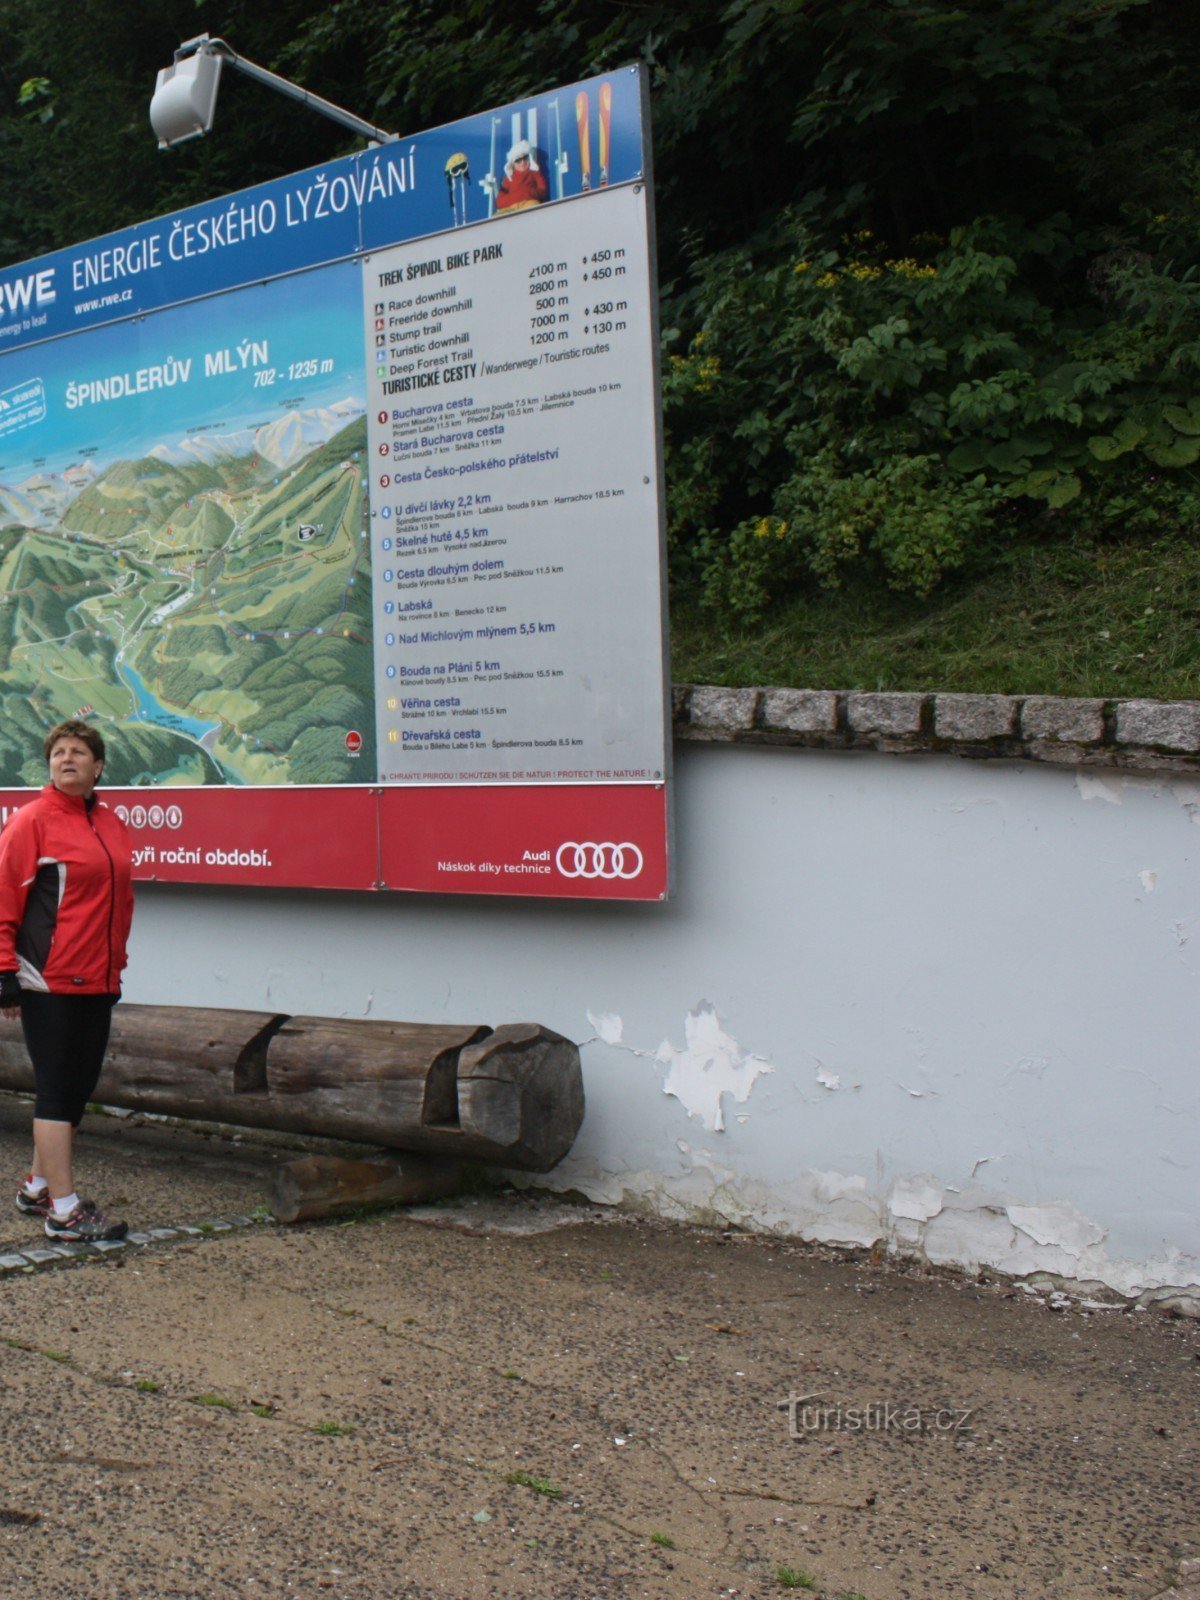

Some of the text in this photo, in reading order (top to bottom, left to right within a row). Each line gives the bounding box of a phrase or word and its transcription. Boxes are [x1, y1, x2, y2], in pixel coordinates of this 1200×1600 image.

[72, 235, 161, 291] ENERGIE
[168, 200, 276, 261] ČESKÉHO
[286, 145, 416, 227] LYŽOVÁNÍ
[378, 243, 503, 287] TREK ŠPINDL BIKE PARK
[528, 248, 626, 279] 2100 m 450 m
[529, 265, 626, 295] 2800 m 450 m
[74, 288, 133, 315] www.rwe.cz
[388, 286, 457, 312] Race downhill
[536, 296, 569, 310] 500 m
[389, 298, 473, 327] Freeride downhill
[530, 300, 628, 329] 7000 m 430 m
[0, 323, 22, 337] energy
[31, 312, 47, 327] lead
[389, 322, 442, 344] Stump trail
[530, 320, 627, 345] 1200 m 130 m
[390, 332, 470, 359] Turistic downhill
[382, 368, 440, 396] TURISTICKÉ
[443, 363, 477, 384] CESTY
[544, 348, 580, 363] Touristic
[582, 343, 610, 356] routes
[390, 348, 473, 375] Deep Forest Trail
[65, 338, 269, 409] ŠPINDLERŮV MLÝN
[253, 358, 334, 388] 702 1235 m
[491, 402, 514, 412] bouda
[527, 397, 539, 405] km
[544, 391, 571, 402] Labská
[573, 387, 597, 397] bouda
[609, 382, 621, 391] km
[392, 397, 474, 421] Bucharova cesta
[522, 406, 534, 415] km
[393, 424, 505, 453] Stará Bucharova cesta
[412, 448, 433, 458] bouda
[490, 438, 502, 446] km
[394, 447, 559, 485] Cesta Česko-polského přátelství
[395, 506, 402, 516] U
[457, 496, 473, 508] 2,2
[475, 494, 491, 504] km
[507, 501, 529, 510] bouda
[537, 499, 549, 507] km
[554, 494, 593, 504] Harrachov
[612, 489, 624, 497] km
[395, 535, 428, 548] Skelné
[454, 529, 470, 541] 4,5
[472, 528, 488, 538] km
[397, 560, 504, 580] Cesta dlouhým dolem
[488, 572, 502, 582] pod
[535, 567, 551, 575] 11.5
[398, 598, 433, 612] Labská
[496, 605, 507, 613] km
[399, 622, 556, 644] Nad Michlovým mlýnem 5,5 km
[400, 665, 431, 677] Bouda
[433, 666, 446, 675] na
[475, 661, 482, 672] 5
[484, 660, 500, 670] km
[488, 673, 502, 682] pod
[552, 668, 564, 677] km
[434, 697, 460, 707] cesta
[402, 728, 481, 741] Dřevařská cesta
[534, 739, 557, 747] bouda
[571, 738, 583, 746] km
[499, 771, 510, 779] SIE
[512, 770, 524, 778] DIE
[526, 770, 551, 778] NATUR
[557, 770, 593, 778] PROTECT
[596, 769, 611, 777] THE
[612, 769, 645, 777] NATURE
[131, 846, 272, 867] yři roční období.
[522, 850, 550, 861] Audi
[437, 860, 551, 875] Náskok díky technice
